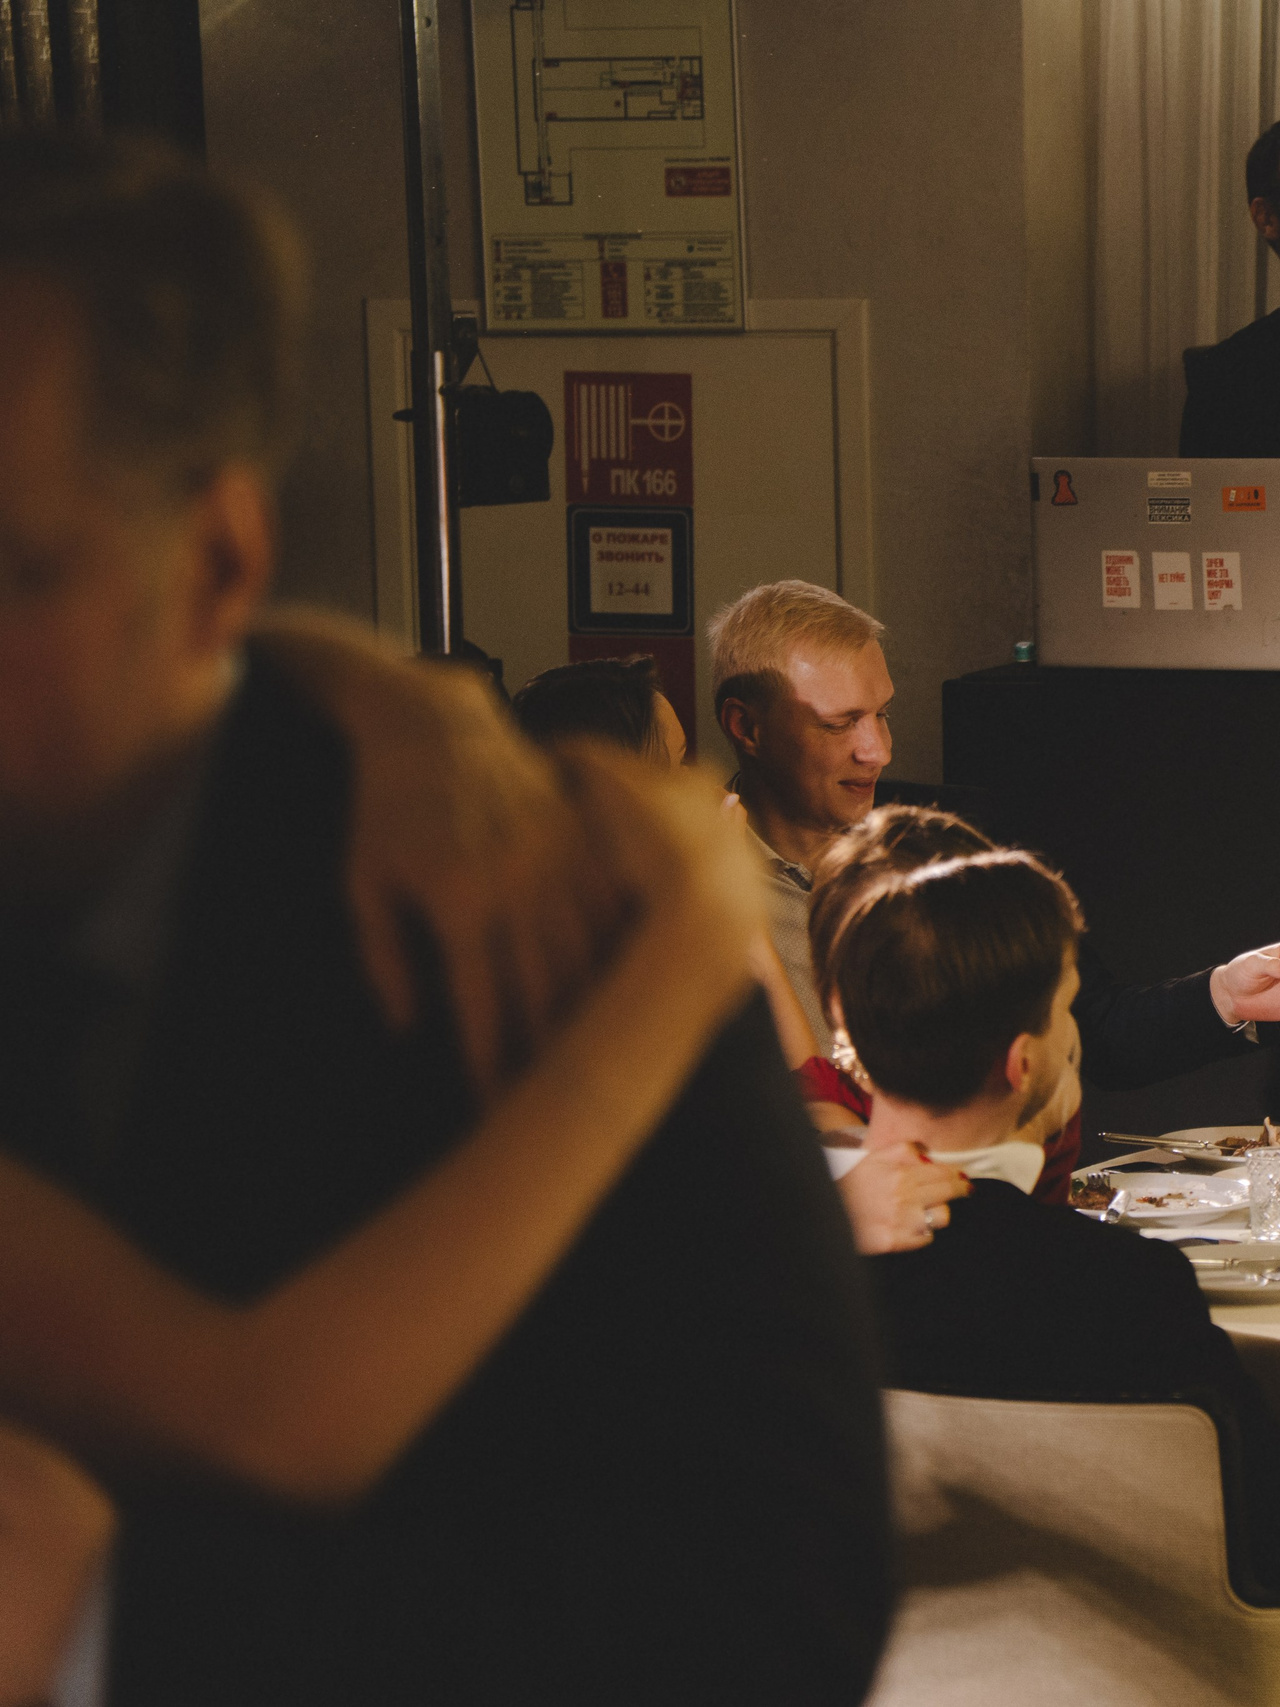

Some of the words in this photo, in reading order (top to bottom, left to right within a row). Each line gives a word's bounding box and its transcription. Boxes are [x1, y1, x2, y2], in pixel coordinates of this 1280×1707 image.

[610, 469, 640, 496] ПК
[642, 469, 677, 496] 166
[1149, 505, 1189, 514] ВНИМАНИЕ
[1150, 514, 1190, 522] ЛЕКСИКА
[592, 533, 602, 545] О
[607, 532, 669, 545] ПОЖАРЕ
[597, 550, 664, 564] ЗВОНИТЬ
[1106, 555, 1133, 566] ХУДОЖНИК
[1206, 558, 1224, 568] ЗАЧЕМ
[1106, 566, 1125, 575] МОЖЕТ
[1206, 568, 1218, 578] МНЕ
[1219, 568, 1229, 578] ЭТА
[1106, 576, 1129, 586] ОБИДЕТЬ
[1158, 573, 1168, 583] НЕТ
[607, 582, 651, 597] 12-44
[1106, 587, 1132, 597] КАЖДОГО
